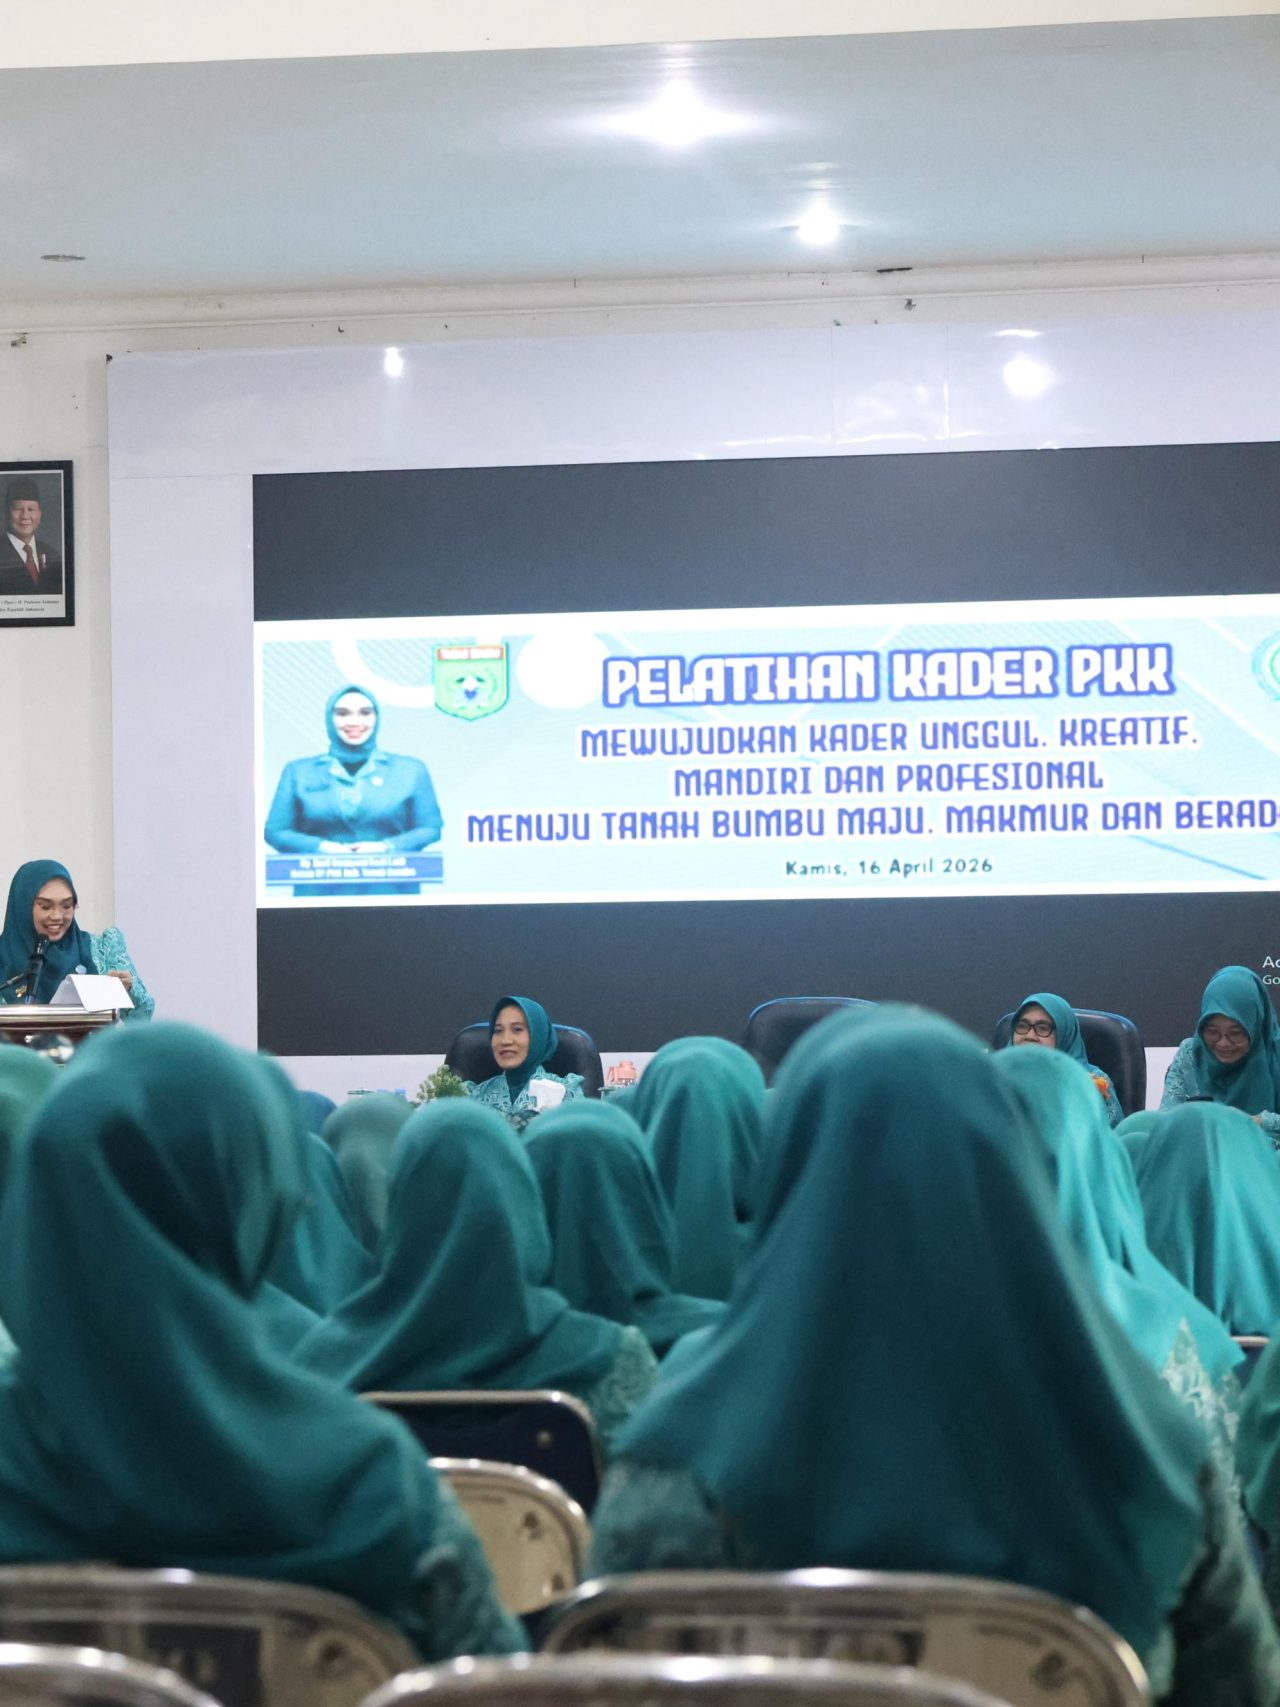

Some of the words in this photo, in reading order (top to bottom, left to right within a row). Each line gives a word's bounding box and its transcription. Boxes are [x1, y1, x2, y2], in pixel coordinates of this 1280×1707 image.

[604, 653, 881, 708] PELATIHAN
[887, 647, 1059, 702] KADER
[1067, 643, 1177, 698] PKK
[582, 726, 796, 757] MEWUJUDKAN
[810, 723, 907, 753] KADER
[675, 767, 811, 797] MANDIRI
[825, 766, 884, 793] DAN
[897, 761, 1103, 791] PROFESIONAL
[468, 814, 590, 842] MENUJU
[602, 811, 699, 840] TANAH
[713, 808, 824, 837] BUMBU
[947, 803, 1088, 833] MAKMUR
[1103, 801, 1161, 830] DAN
[1175, 799, 1280, 829] BERAD
[786, 860, 847, 876] Kamis,
[859, 860, 880, 874] 16
[889, 858, 933, 878] April
[943, 858, 993, 873] 2026
